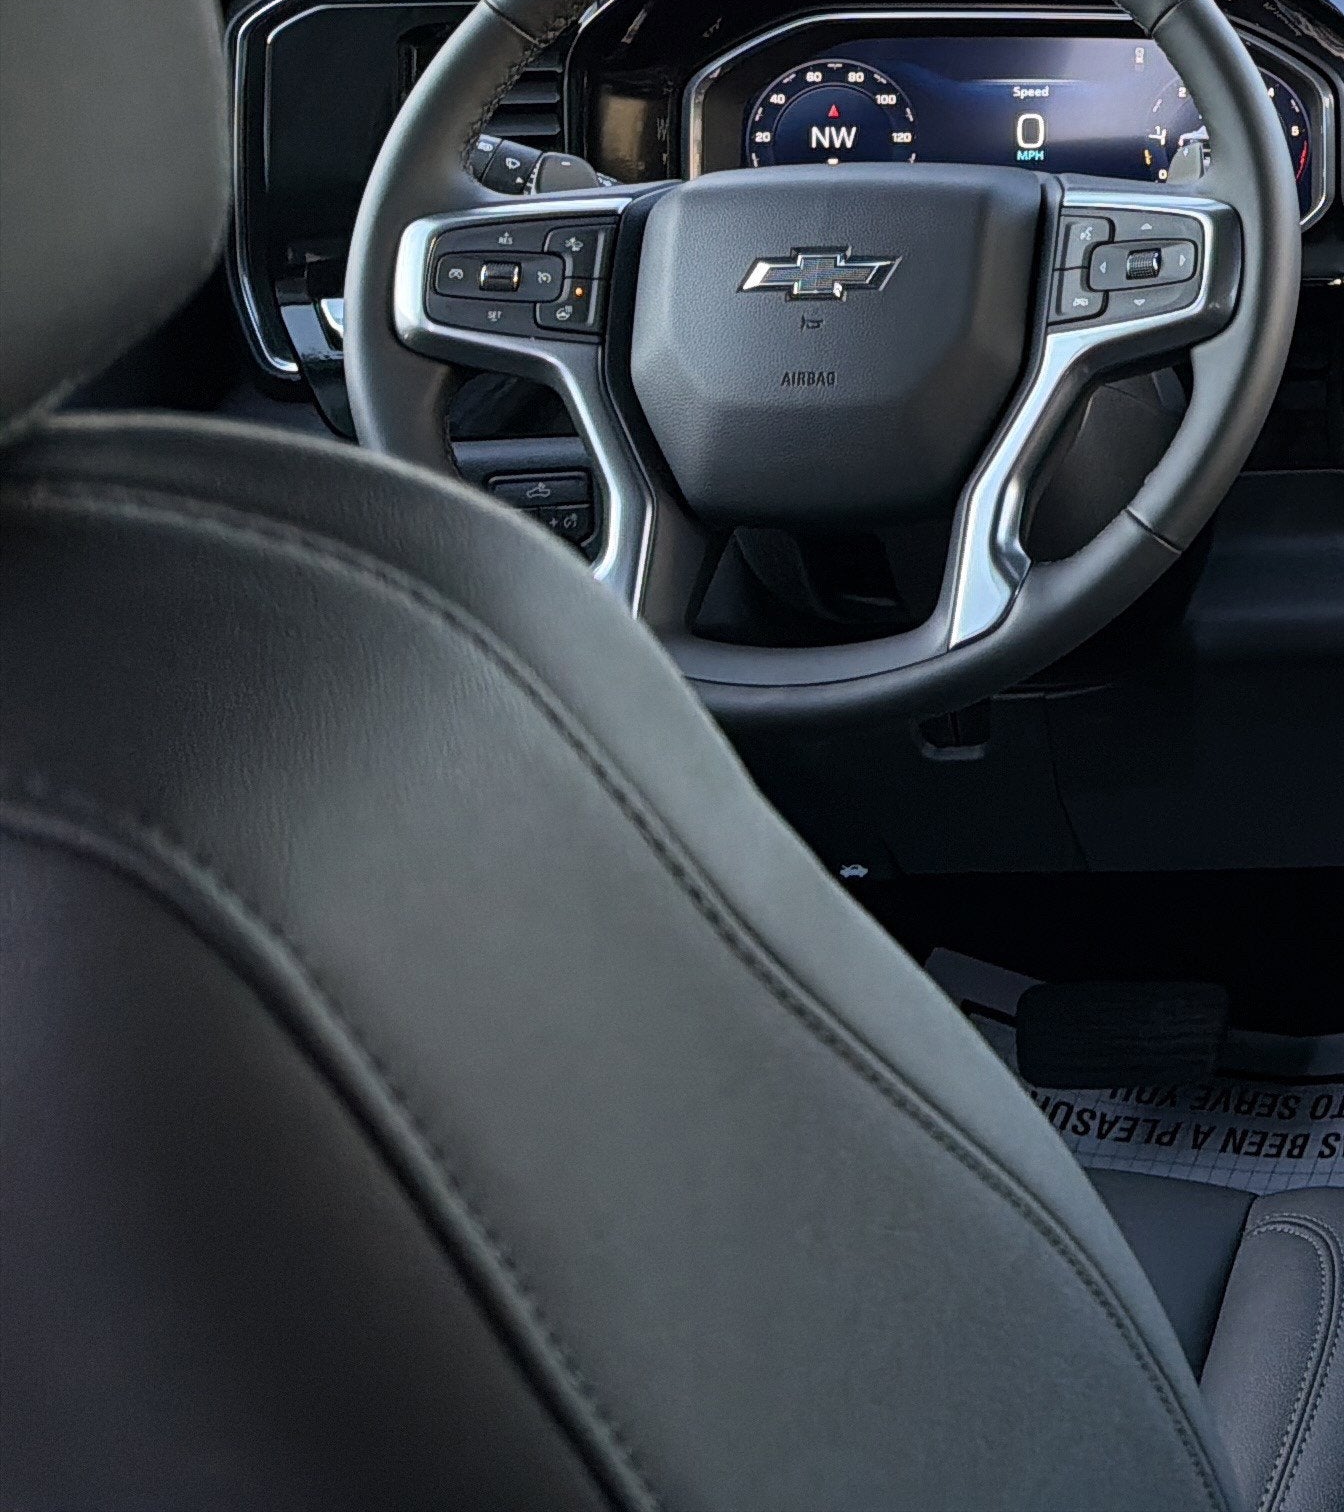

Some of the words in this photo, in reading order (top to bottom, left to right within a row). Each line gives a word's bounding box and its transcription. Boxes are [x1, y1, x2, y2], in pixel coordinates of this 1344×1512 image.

[805, 71, 823, 83] 60
[848, 71, 865, 83] 80
[1013, 85, 1050, 99] Speed
[1178, 86, 1187, 98] 2
[769, 93, 786, 105] 40
[875, 93, 897, 105] 100
[755, 131, 771, 143] 20
[1017, 113, 1045, 149] 0
[811, 126, 857, 149] NW
[891, 132, 912, 143] 120
[1016, 150, 1045, 161] MPH
[1158, 168, 1168, 180] 0
[487, 310, 502, 319] SET
[780, 371, 836, 386] AIRBAG
[1190, 1086, 1299, 1120] SERVE
[1191, 1123, 1217, 1149] A
[1218, 1124, 1313, 1159] BEEN
